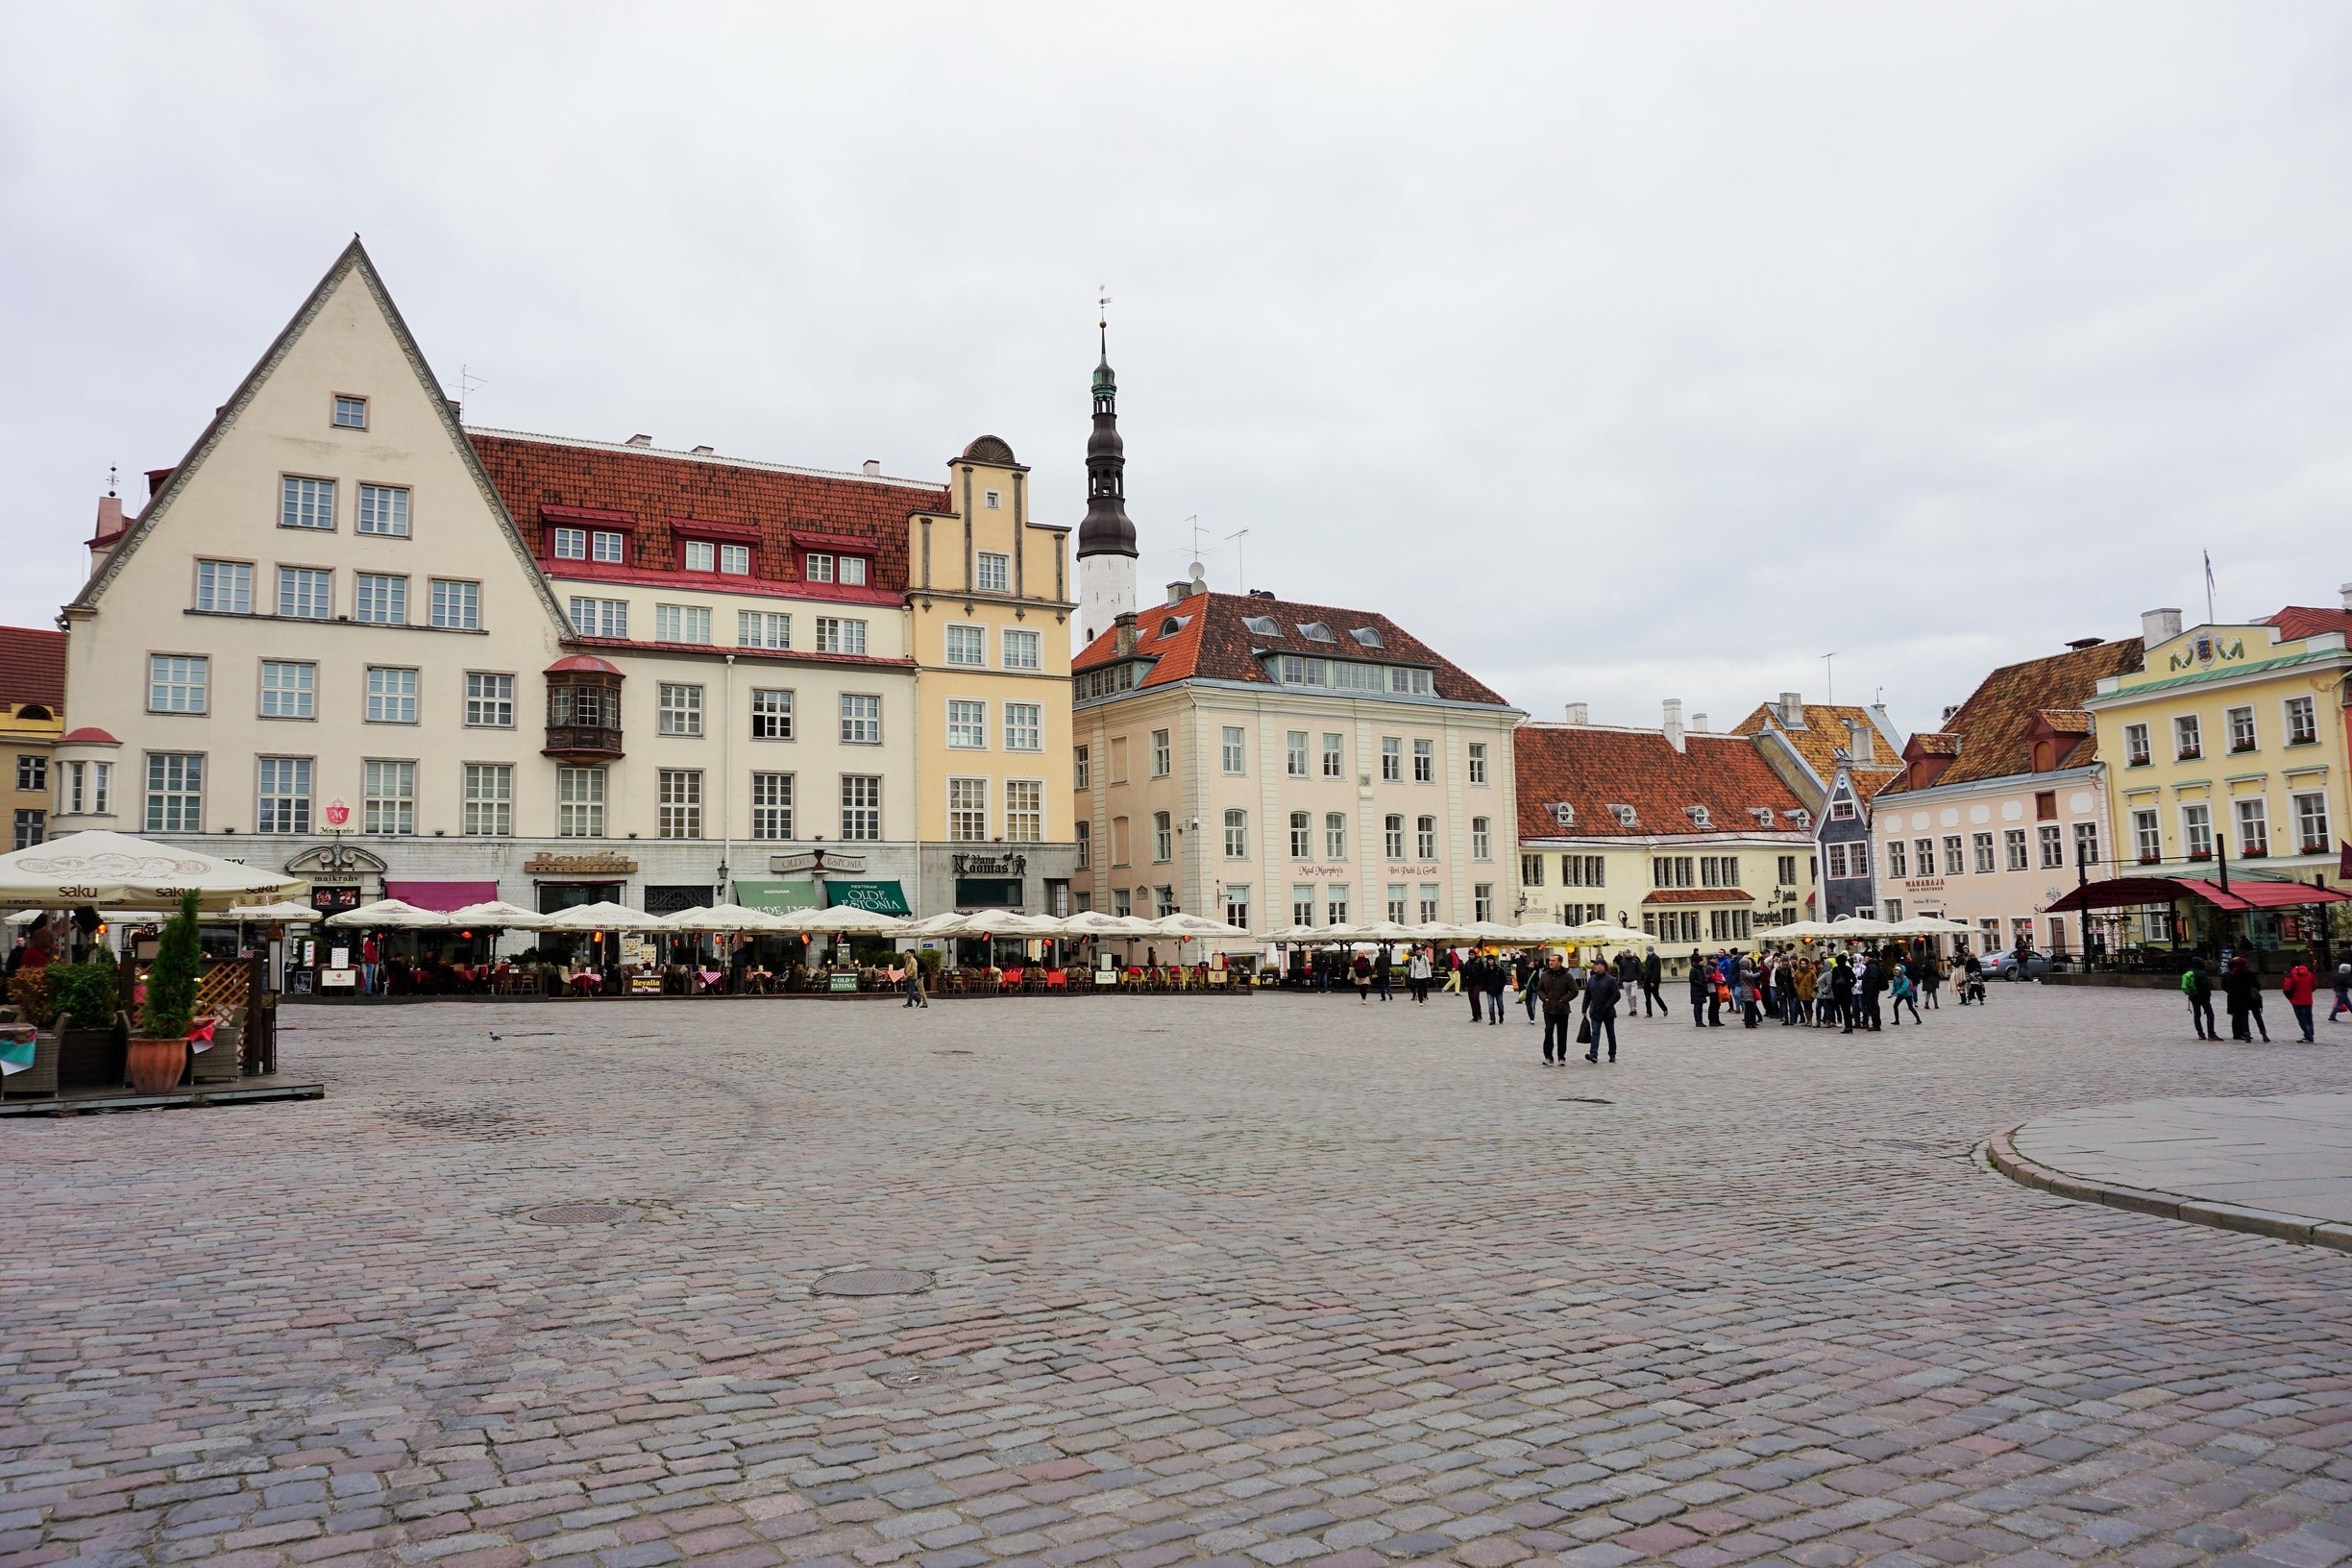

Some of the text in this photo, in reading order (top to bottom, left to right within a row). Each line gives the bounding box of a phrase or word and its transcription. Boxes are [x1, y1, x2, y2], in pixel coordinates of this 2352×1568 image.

[533, 851, 628, 866] Revalia
[827, 857, 863, 869] ESTONIA
[970, 854, 996, 865] Vana
[1299, 866, 1343, 876] Mad Murphy's
[1423, 867, 1437, 875] Grill
[59, 884, 98, 898] saku
[848, 890, 888, 901] OLDE
[842, 899, 901, 911] ESTONIA
